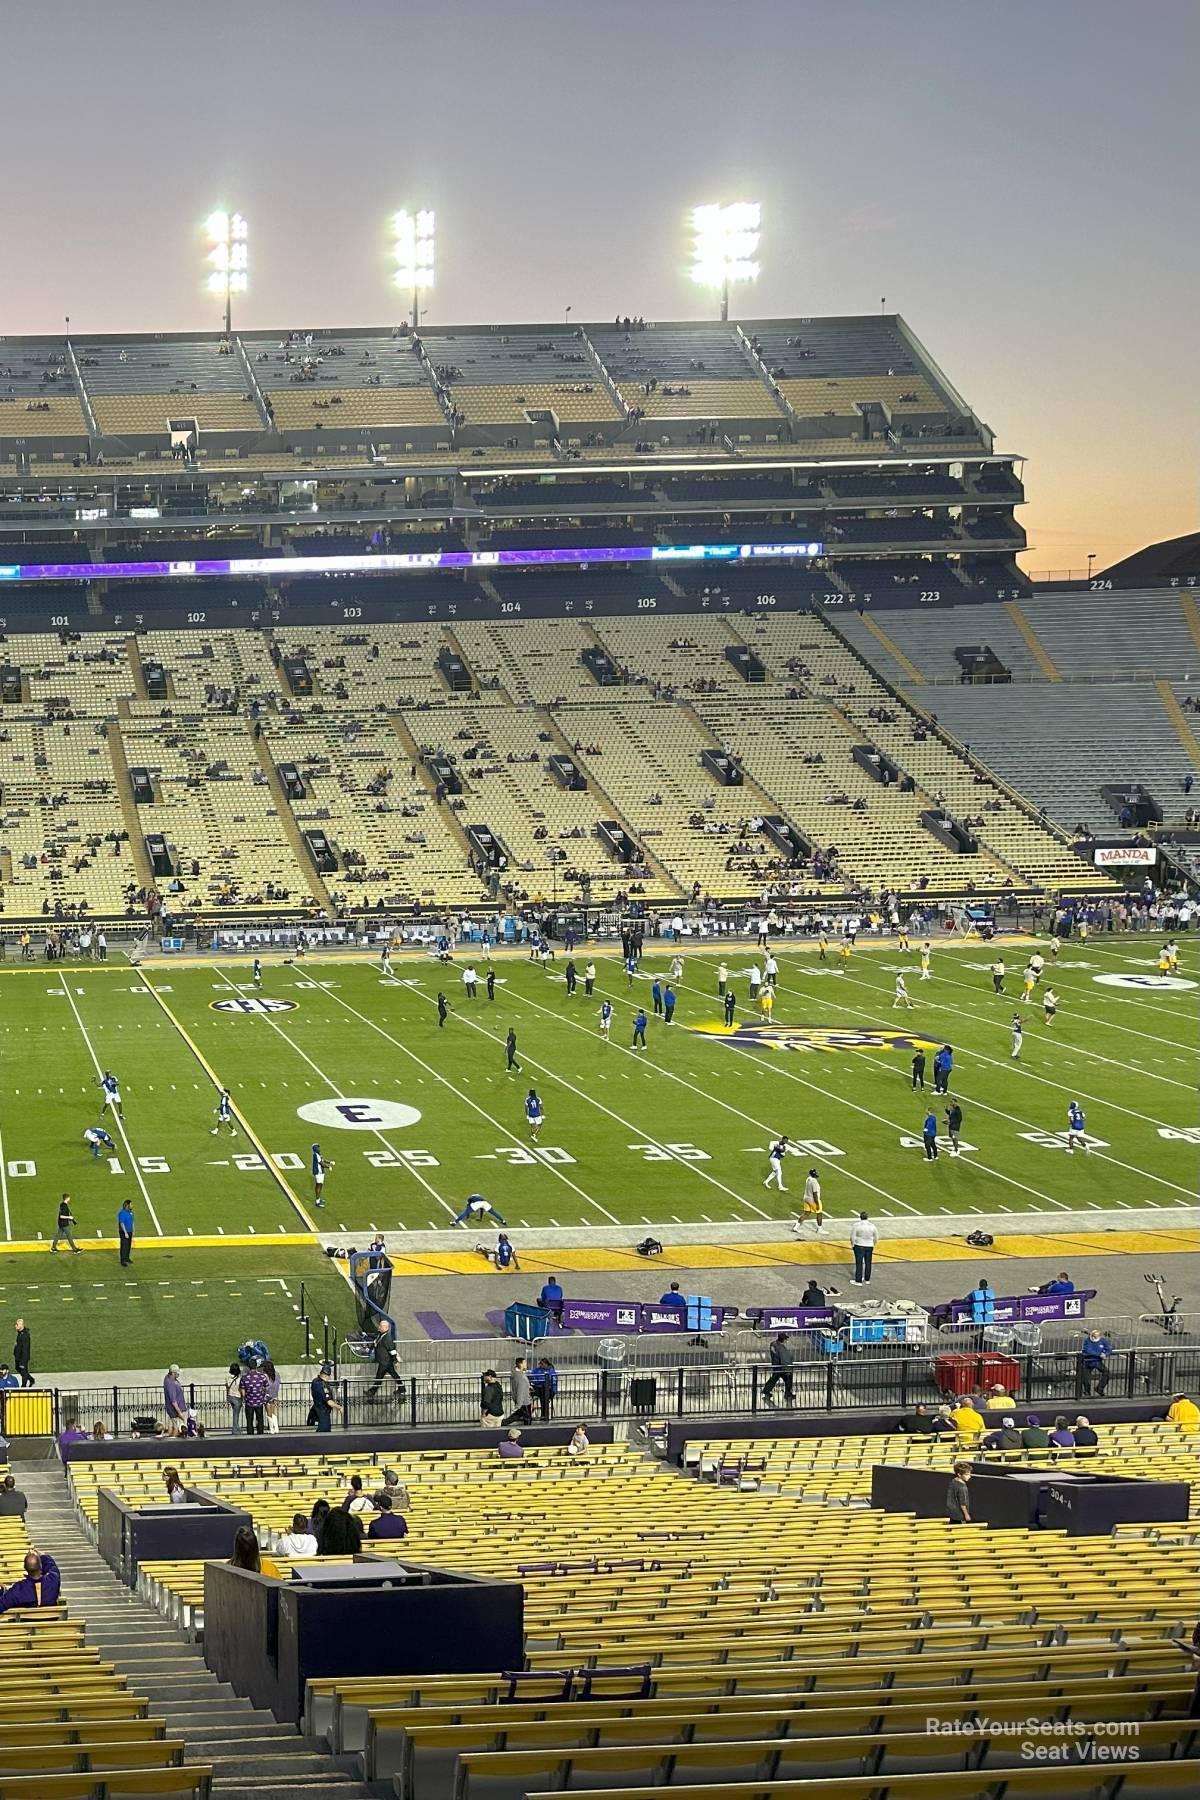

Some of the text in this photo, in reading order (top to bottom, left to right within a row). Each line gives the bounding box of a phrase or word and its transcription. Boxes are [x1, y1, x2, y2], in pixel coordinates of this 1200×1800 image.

[472, 552, 499, 564] LSU
[169, 561, 196, 573] LSU
[1089, 580, 1113, 590] 224
[756, 595, 776, 606] 106
[823, 593, 844, 604] 222
[919, 591, 941, 602] 223
[500, 602, 521, 613] 104
[637, 598, 657, 609] 105
[187, 612, 206, 622] 102
[342, 607, 362, 618] 103
[50, 616, 70, 626] 101
[1100, 849, 1150, 862] MANDA
[47, 987, 86, 996] 15
[129, 985, 175, 993] 20
[107, 1155, 171, 1174] 15
[231, 1153, 306, 1171] 20
[362, 1150, 440, 1168] 25
[495, 1147, 577, 1164] 30
[627, 1143, 713, 1161] 35
[1050, 1487, 1072, 1510] 304-A
